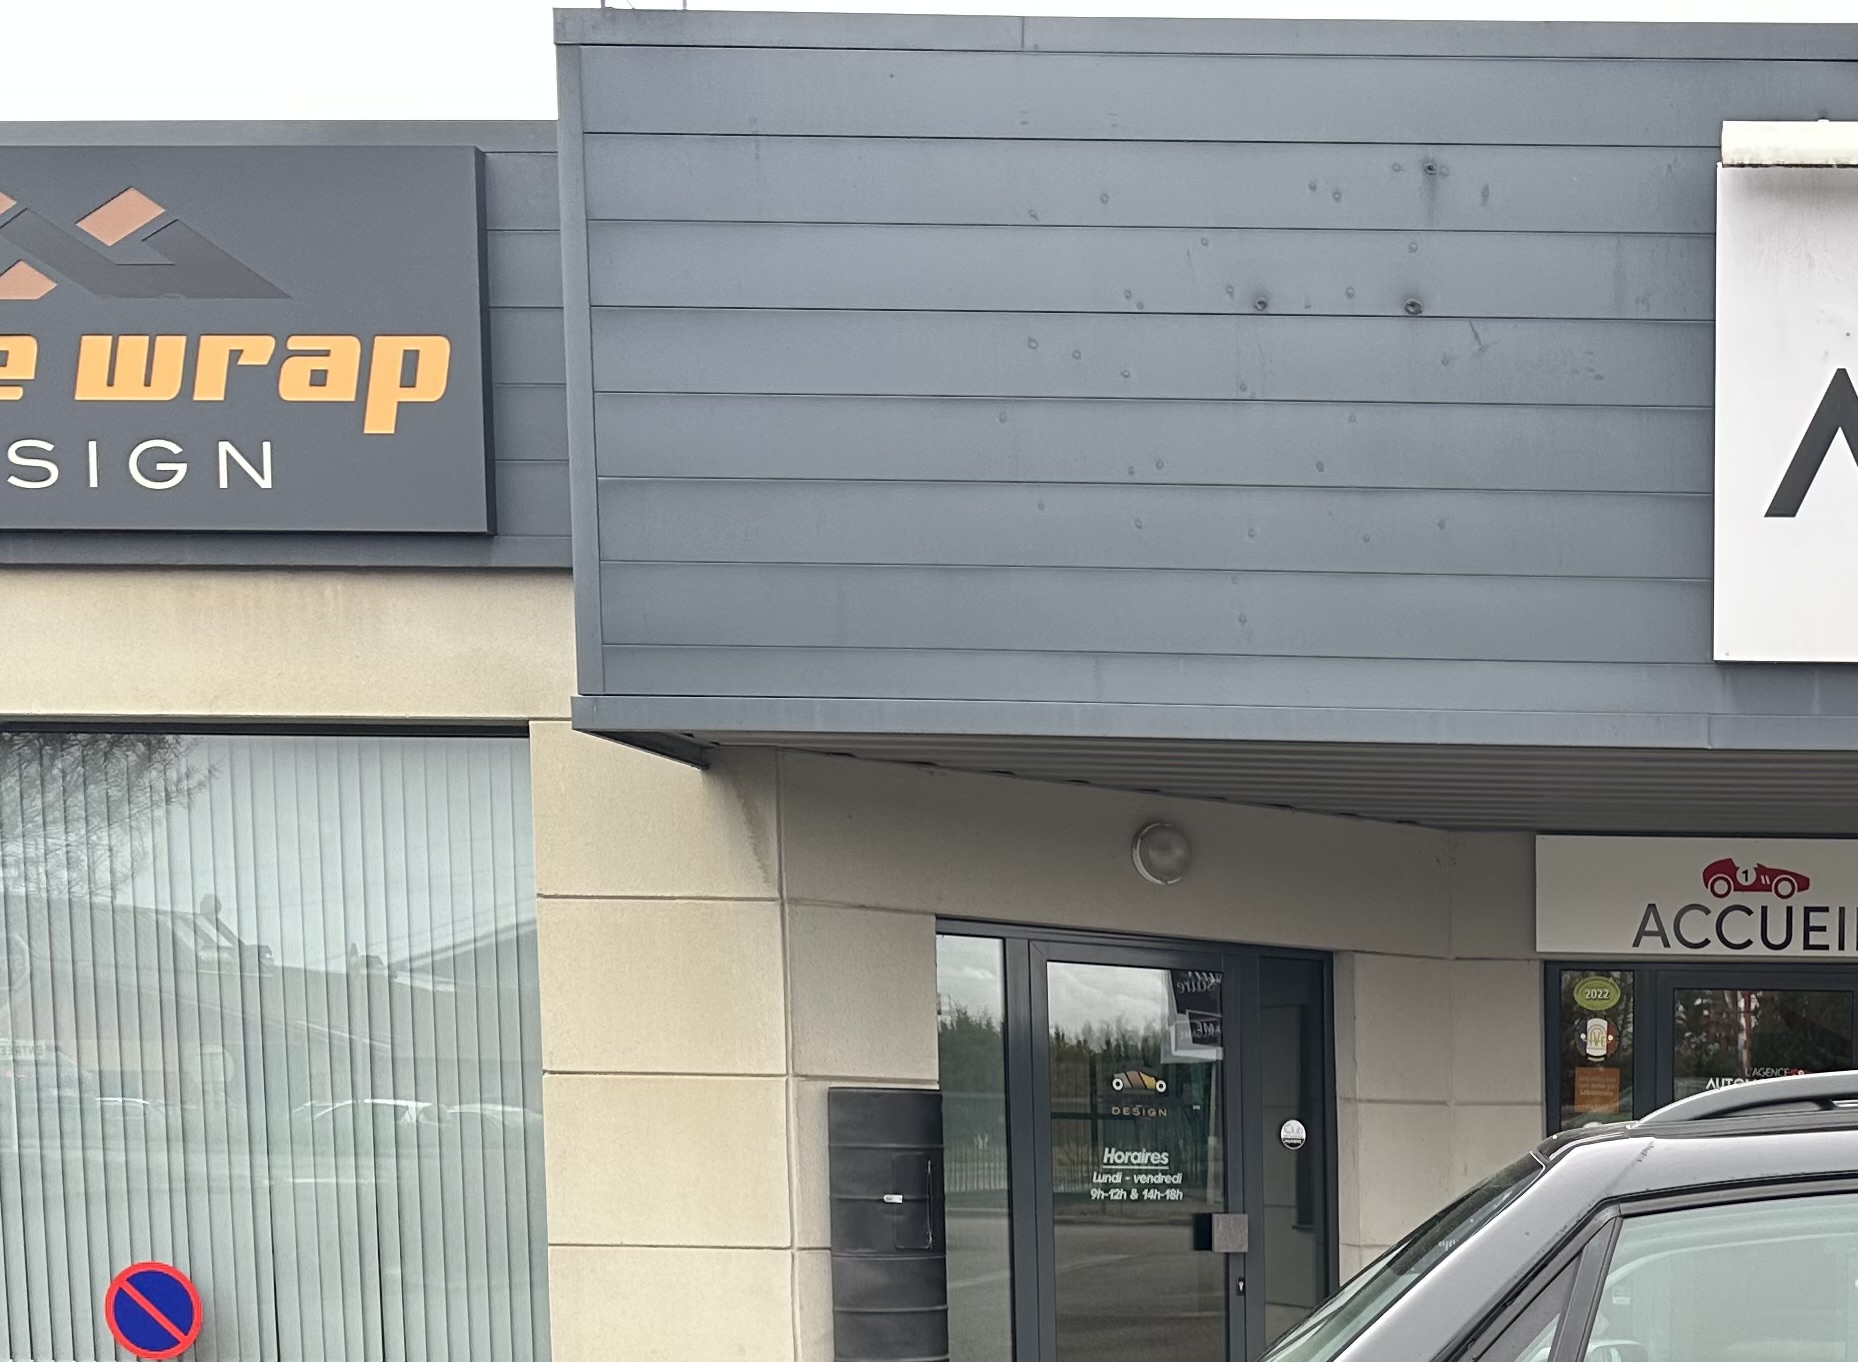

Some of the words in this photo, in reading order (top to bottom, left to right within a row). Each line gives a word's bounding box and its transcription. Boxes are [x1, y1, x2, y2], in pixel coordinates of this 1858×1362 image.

[74, 334, 451, 434] wrap
[7, 438, 273, 490] SIGN
[1584, 988, 1610, 1000] 2022
[1111, 1106, 1168, 1117] DESIGN
[1103, 1147, 1170, 1165] Horaires
[1092, 1171, 1123, 1184] Lundi
[1133, 1172, 1183, 1184] vendredi
[1090, 1188, 1127, 1200] 9h-12h
[1130, 1188, 1139, 1200] &
[1142, 1189, 1183, 1201] 14h-18h
